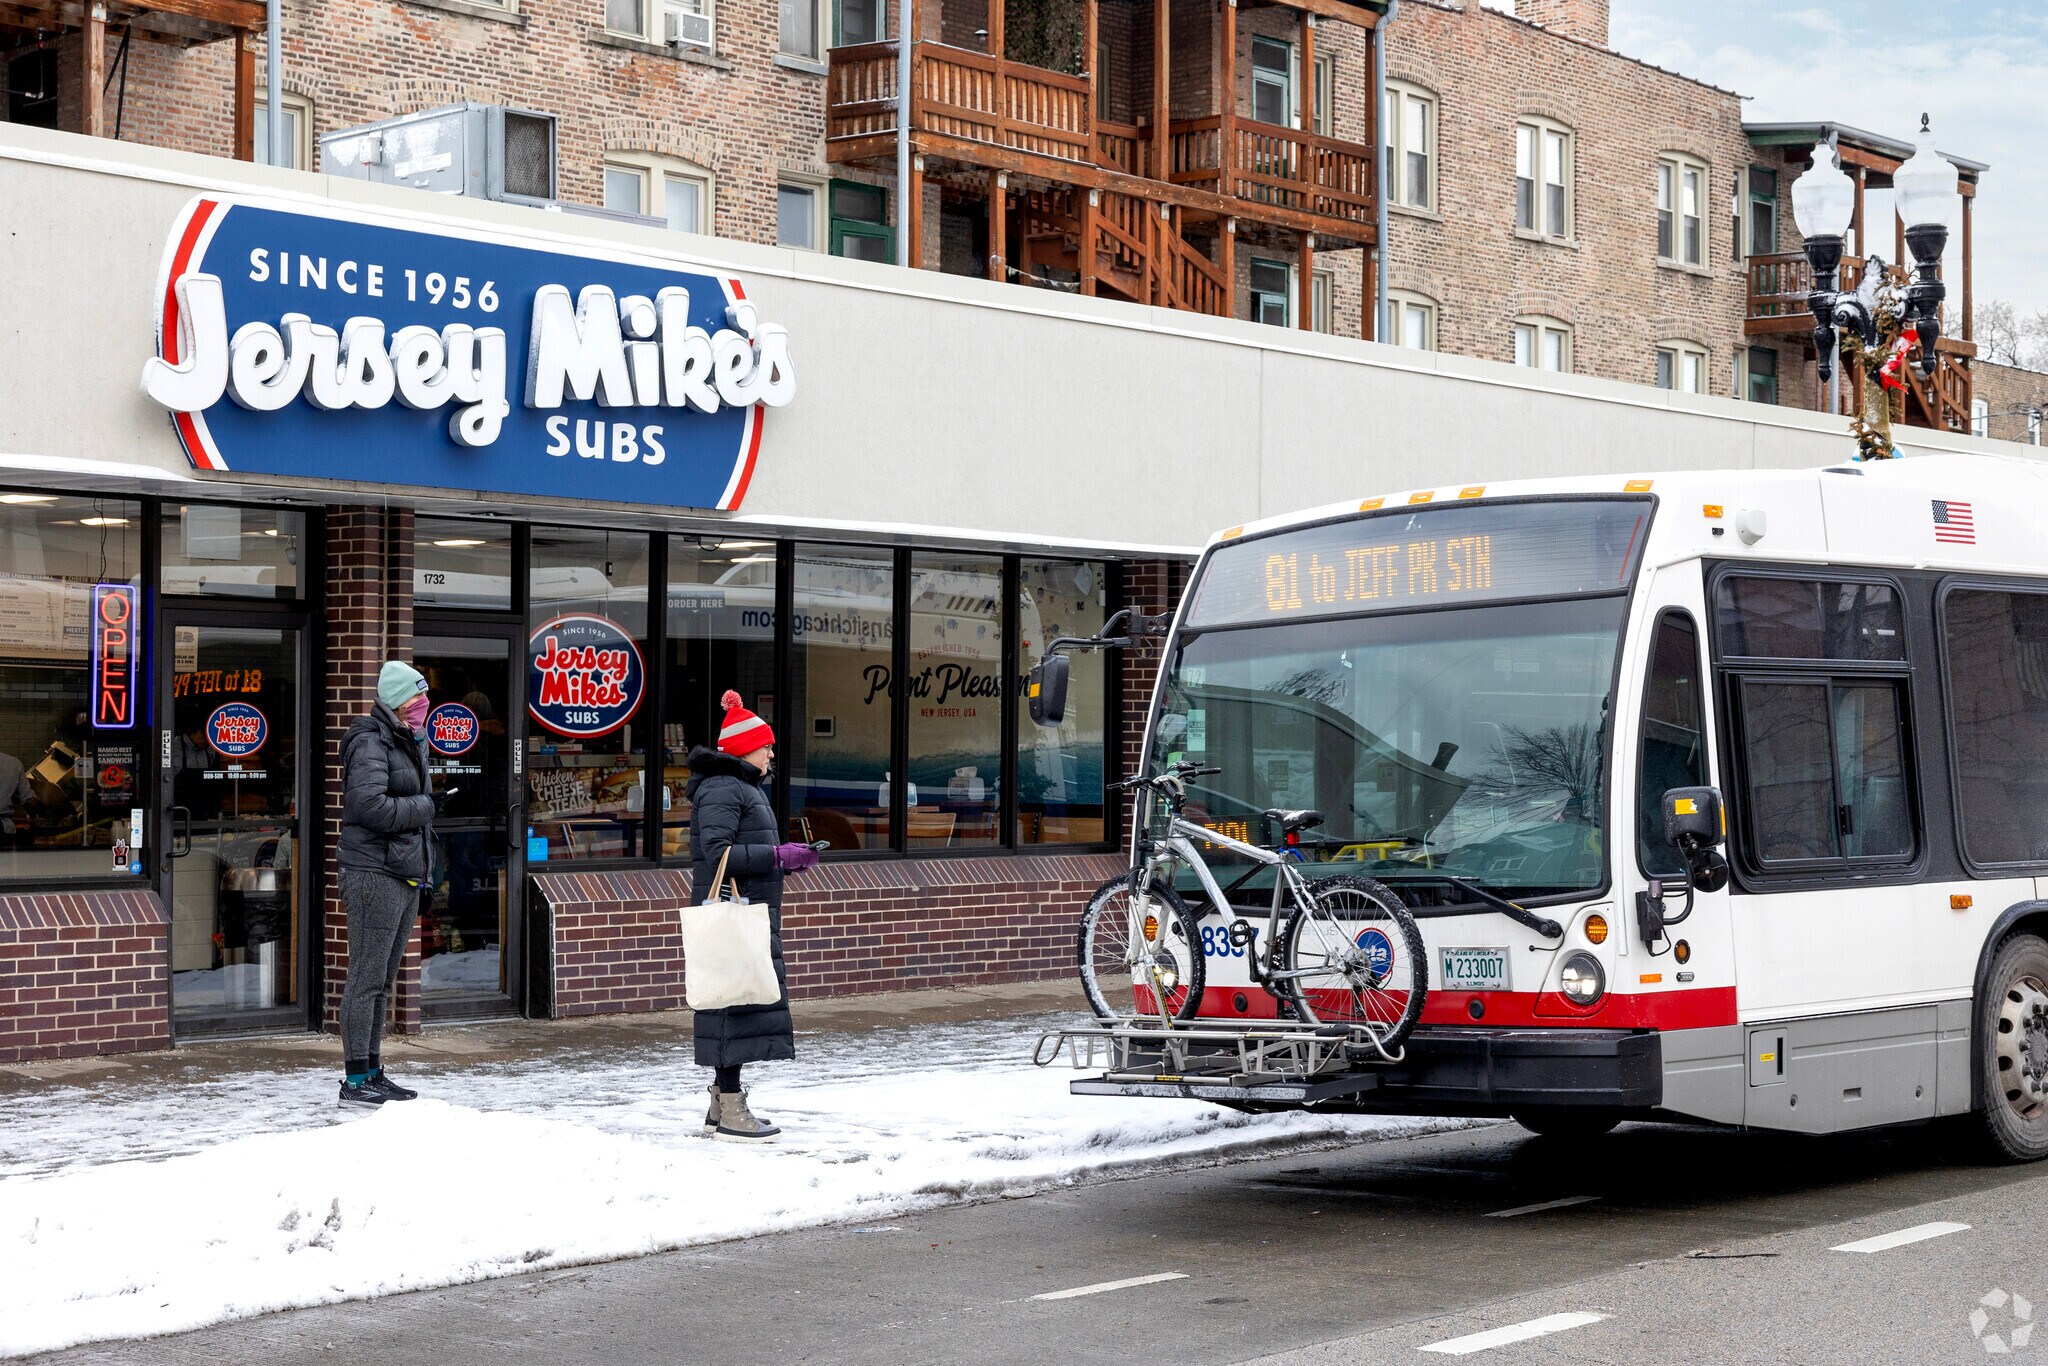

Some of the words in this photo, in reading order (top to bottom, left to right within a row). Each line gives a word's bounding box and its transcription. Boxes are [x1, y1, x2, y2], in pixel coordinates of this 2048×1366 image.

[249, 248, 383, 297] SINCE
[404, 269, 500, 313] 1956
[140, 272, 511, 447] Jersey
[524, 284, 797, 414] Mike's
[545, 415, 666, 466] SUBS
[423, 574, 445, 584] 1732
[1265, 553, 1302, 610] 81
[1309, 554, 1336, 603] to
[1344, 545, 1400, 600] JEFF
[1408, 541, 1437, 594] PK
[667, 600, 698, 608] ORDER
[700, 600, 724, 609] HERE
[562, 627, 585, 636] SINCE
[588, 628, 607, 639] 1956
[101, 592, 130, 721] OPEN
[534, 635, 629, 682] Jersey
[918, 643, 961, 660] ESTABLISHED
[539, 670, 628, 708] Mike's
[215, 711, 260, 732] Jersey
[432, 713, 473, 731] Jersey
[565, 711, 600, 724] SUBS
[920, 708, 934, 718] NEW
[963, 708, 976, 718] USA
[217, 726, 259, 744] Mike's
[434, 726, 472, 742] Mike's
[531, 769, 576, 792] Chicken
[537, 780, 585, 801] CHEESE
[547, 792, 593, 815] STEAKS
[1456, 957, 1503, 978] 233007
